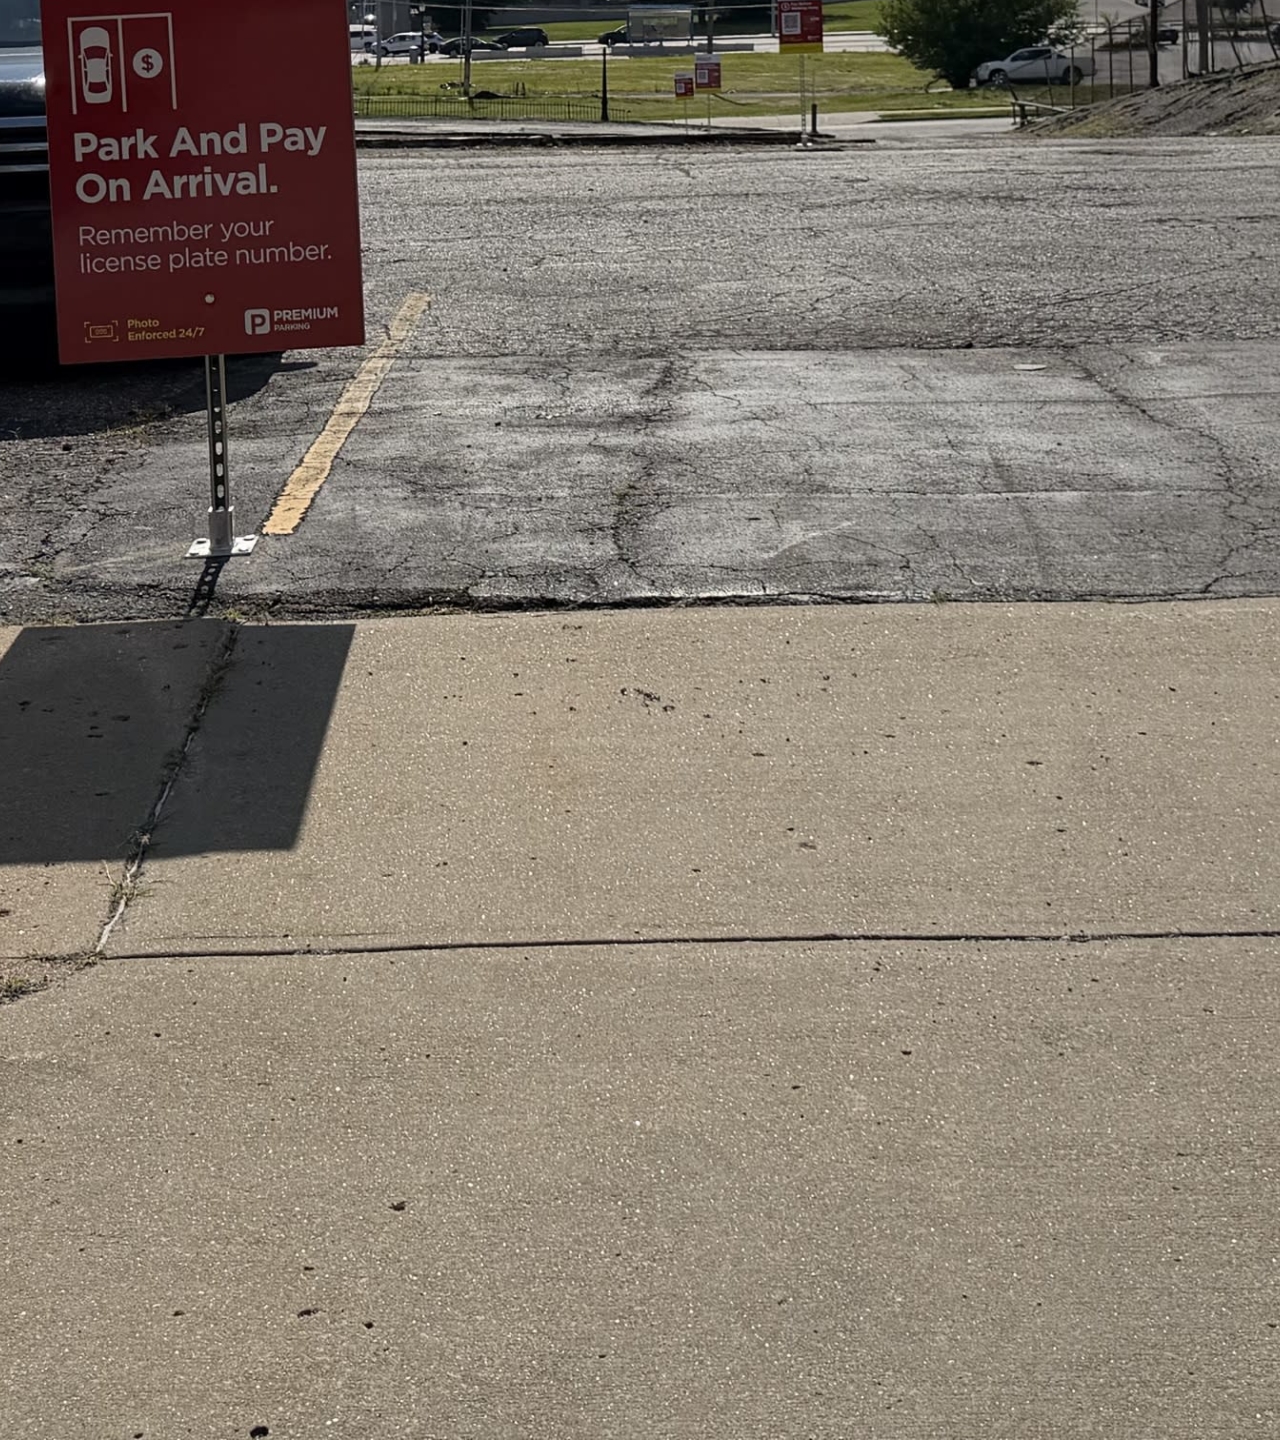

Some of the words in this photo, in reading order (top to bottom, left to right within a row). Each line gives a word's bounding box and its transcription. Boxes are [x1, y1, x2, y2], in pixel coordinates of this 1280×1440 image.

[73, 128, 159, 162] Park
[169, 123, 247, 158] And
[259, 122, 328, 156] Pay
[75, 173, 131, 204] On
[142, 163, 279, 200] Arrival.
[79, 221, 213, 247] Remember
[220, 220, 275, 243] your
[80, 253, 162, 274] license
[169, 247, 229, 273] plate
[235, 242, 332, 265] number.
[127, 319, 160, 329] Photo
[273, 306, 339, 322] PREMIUM
[128, 329, 177, 341] Enforced
[178, 327, 205, 339] 24/7
[274, 322, 311, 332] PARKING
